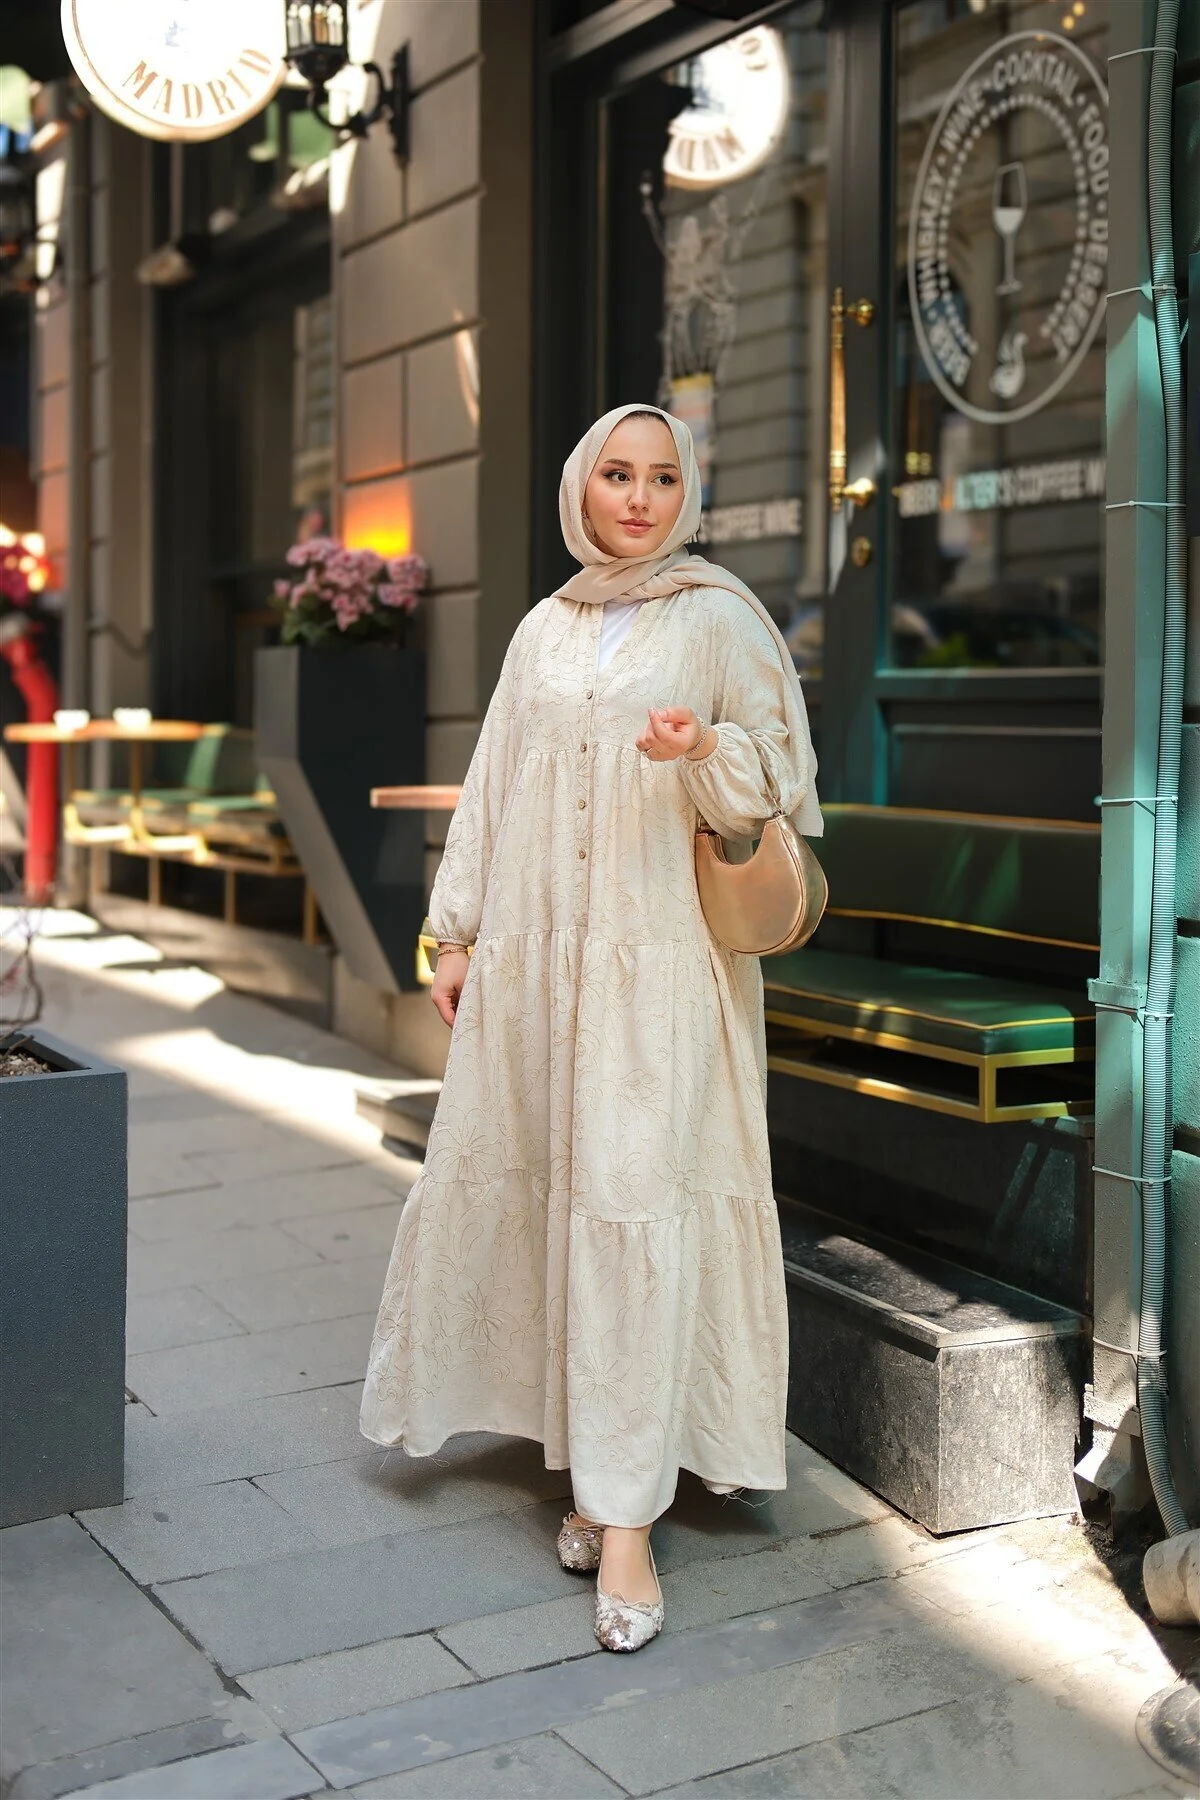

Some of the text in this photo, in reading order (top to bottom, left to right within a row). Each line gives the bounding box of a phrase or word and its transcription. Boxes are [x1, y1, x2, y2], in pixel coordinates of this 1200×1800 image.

[121, 48, 272, 119] MADRID
[939, 80, 985, 153] WINE
[992, 50, 1080, 108] COCKTAIL
